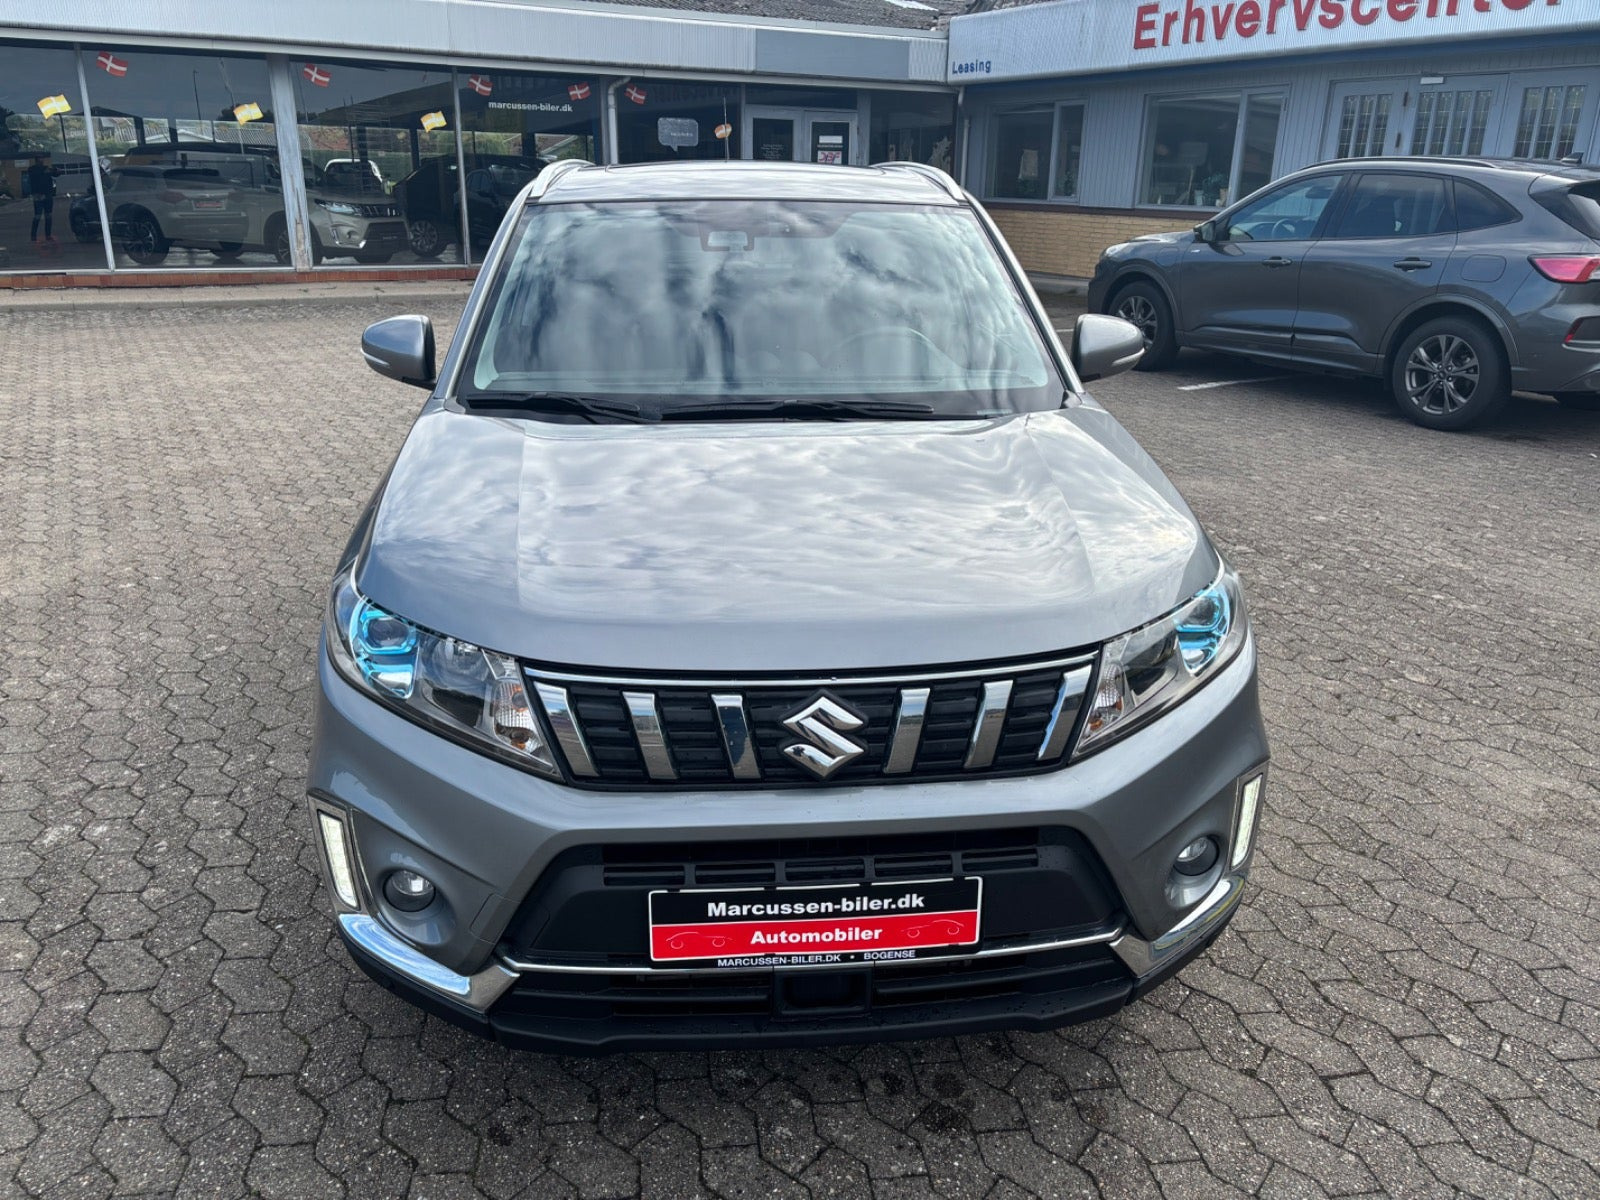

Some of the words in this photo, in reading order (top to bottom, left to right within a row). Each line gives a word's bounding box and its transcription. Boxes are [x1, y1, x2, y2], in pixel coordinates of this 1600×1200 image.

[1133, 0, 1562, 49] Erhvervscen
[952, 60, 992, 74] Leasing
[488, 101, 573, 113] marcussen-biler.dk
[707, 893, 925, 917] Marcussen-biler.dk
[750, 927, 883, 945] Automobiler
[717, 954, 841, 968] MARCUSSEN-BILER.DK
[863, 949, 916, 961] BOGENSE
